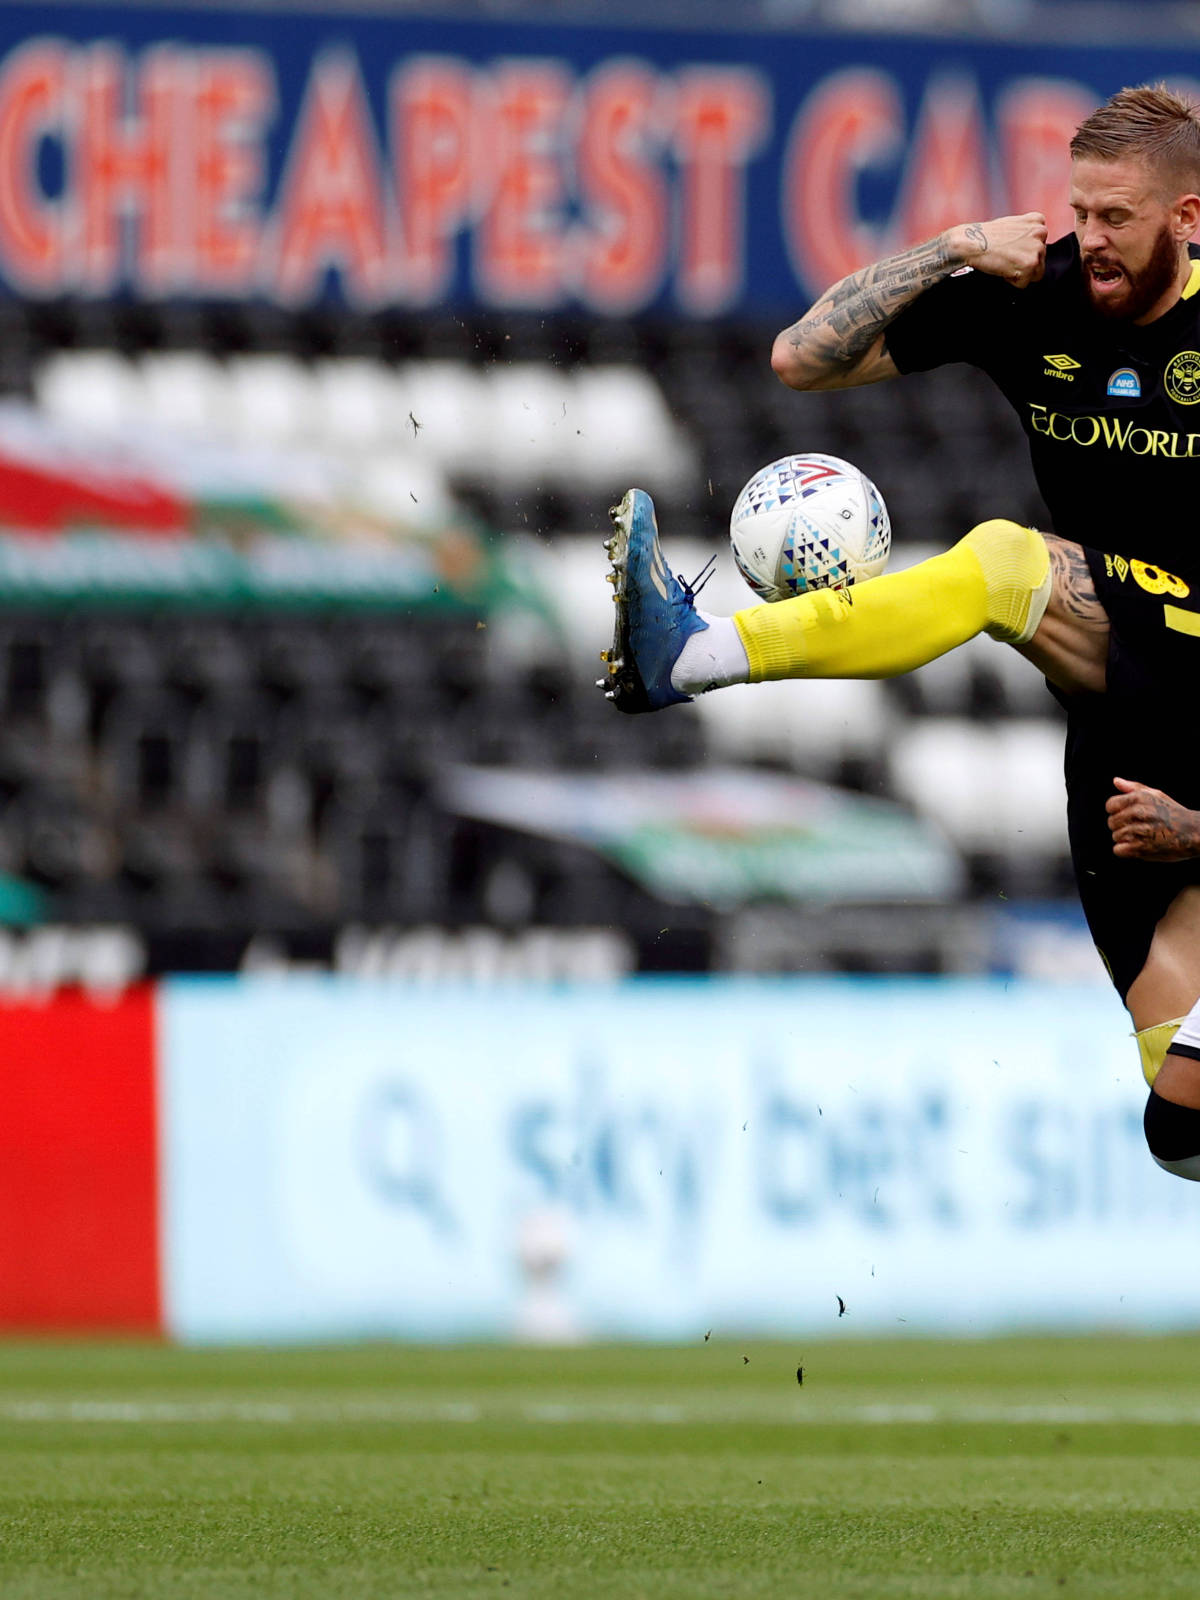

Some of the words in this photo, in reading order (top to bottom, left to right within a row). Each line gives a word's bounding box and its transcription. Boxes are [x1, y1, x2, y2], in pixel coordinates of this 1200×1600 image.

[0, 36, 772, 312] CHEAPEST
[1043, 368, 1074, 382] umbro
[1115, 379, 1135, 388] NHS
[1129, 558, 1190, 598] 8
